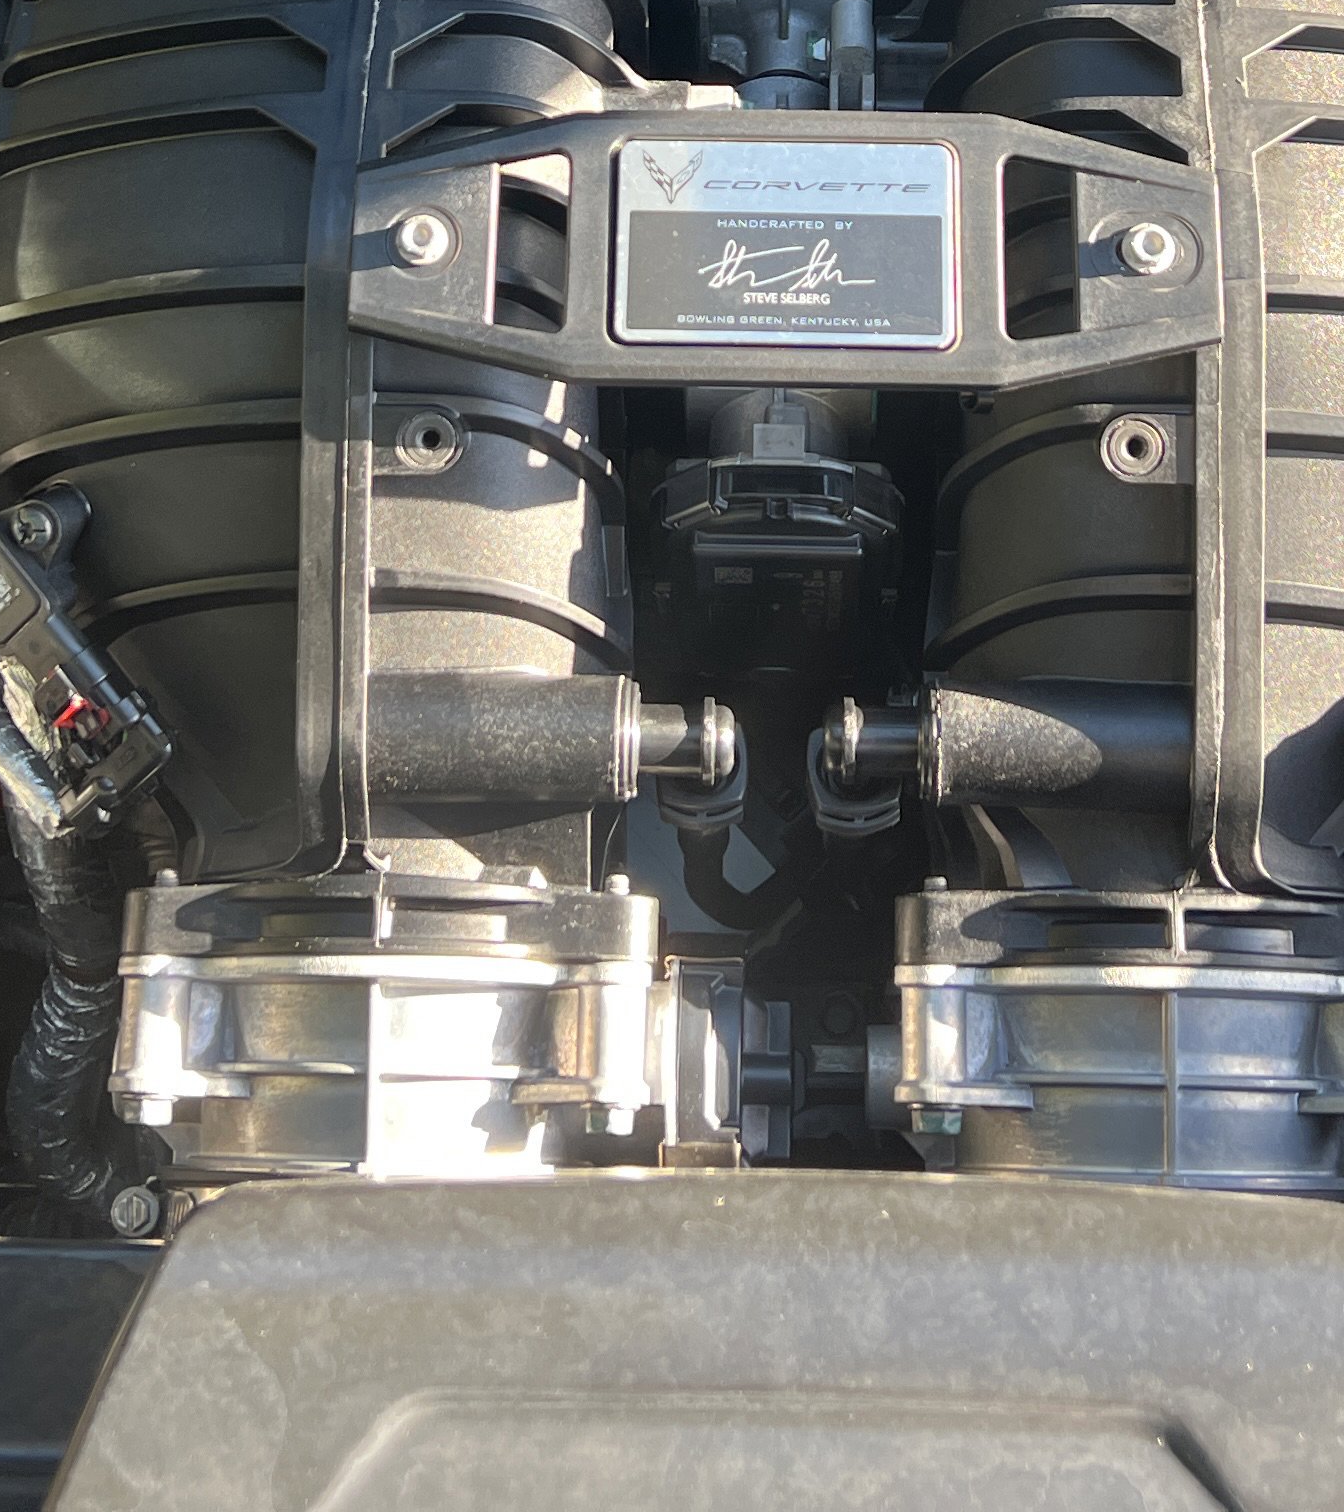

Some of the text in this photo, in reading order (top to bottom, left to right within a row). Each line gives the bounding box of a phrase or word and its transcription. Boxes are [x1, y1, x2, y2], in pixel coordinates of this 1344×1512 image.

[703, 179, 931, 193] CORVETTE
[716, 218, 854, 230] HANDCRAFTED BY
[743, 292, 831, 305] STEVE SELBERG
[677, 314, 736, 324] BOWLING
[864, 317, 891, 327] USA
